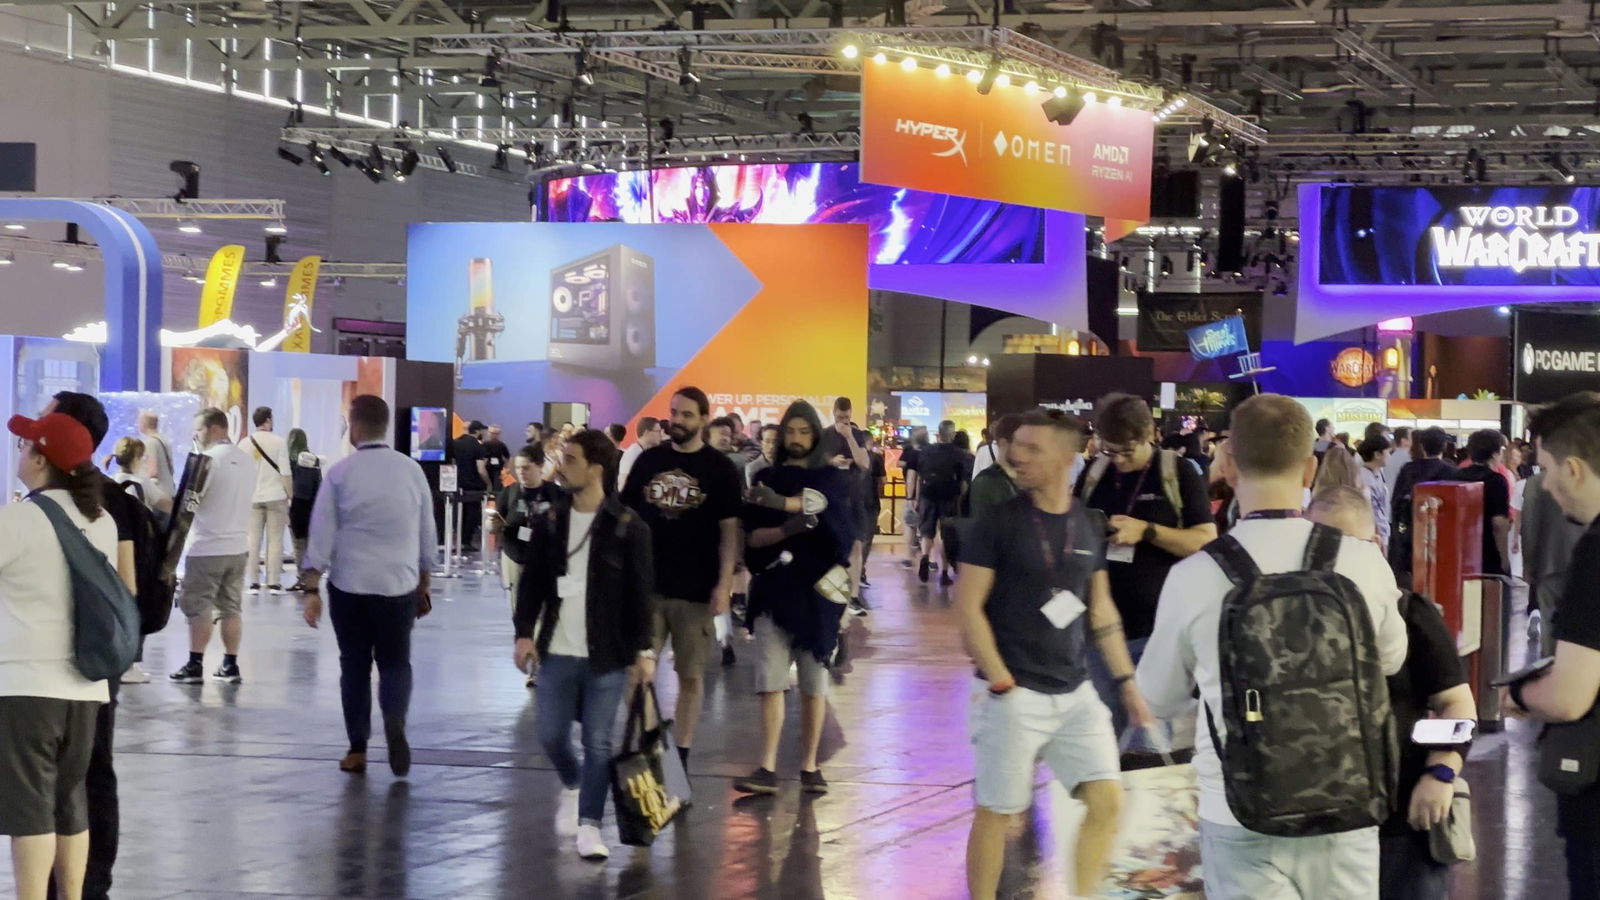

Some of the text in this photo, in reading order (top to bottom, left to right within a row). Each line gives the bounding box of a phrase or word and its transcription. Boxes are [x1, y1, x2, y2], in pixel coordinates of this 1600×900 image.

[1011, 135, 1071, 166] OMEN
[1092, 143, 1120, 164] AMD
[1091, 164, 1124, 181] RYZEN
[1460, 206, 1579, 230] WORLD
[1431, 226, 1600, 273] WARCRAFT
[214, 250, 236, 316] POMMES
